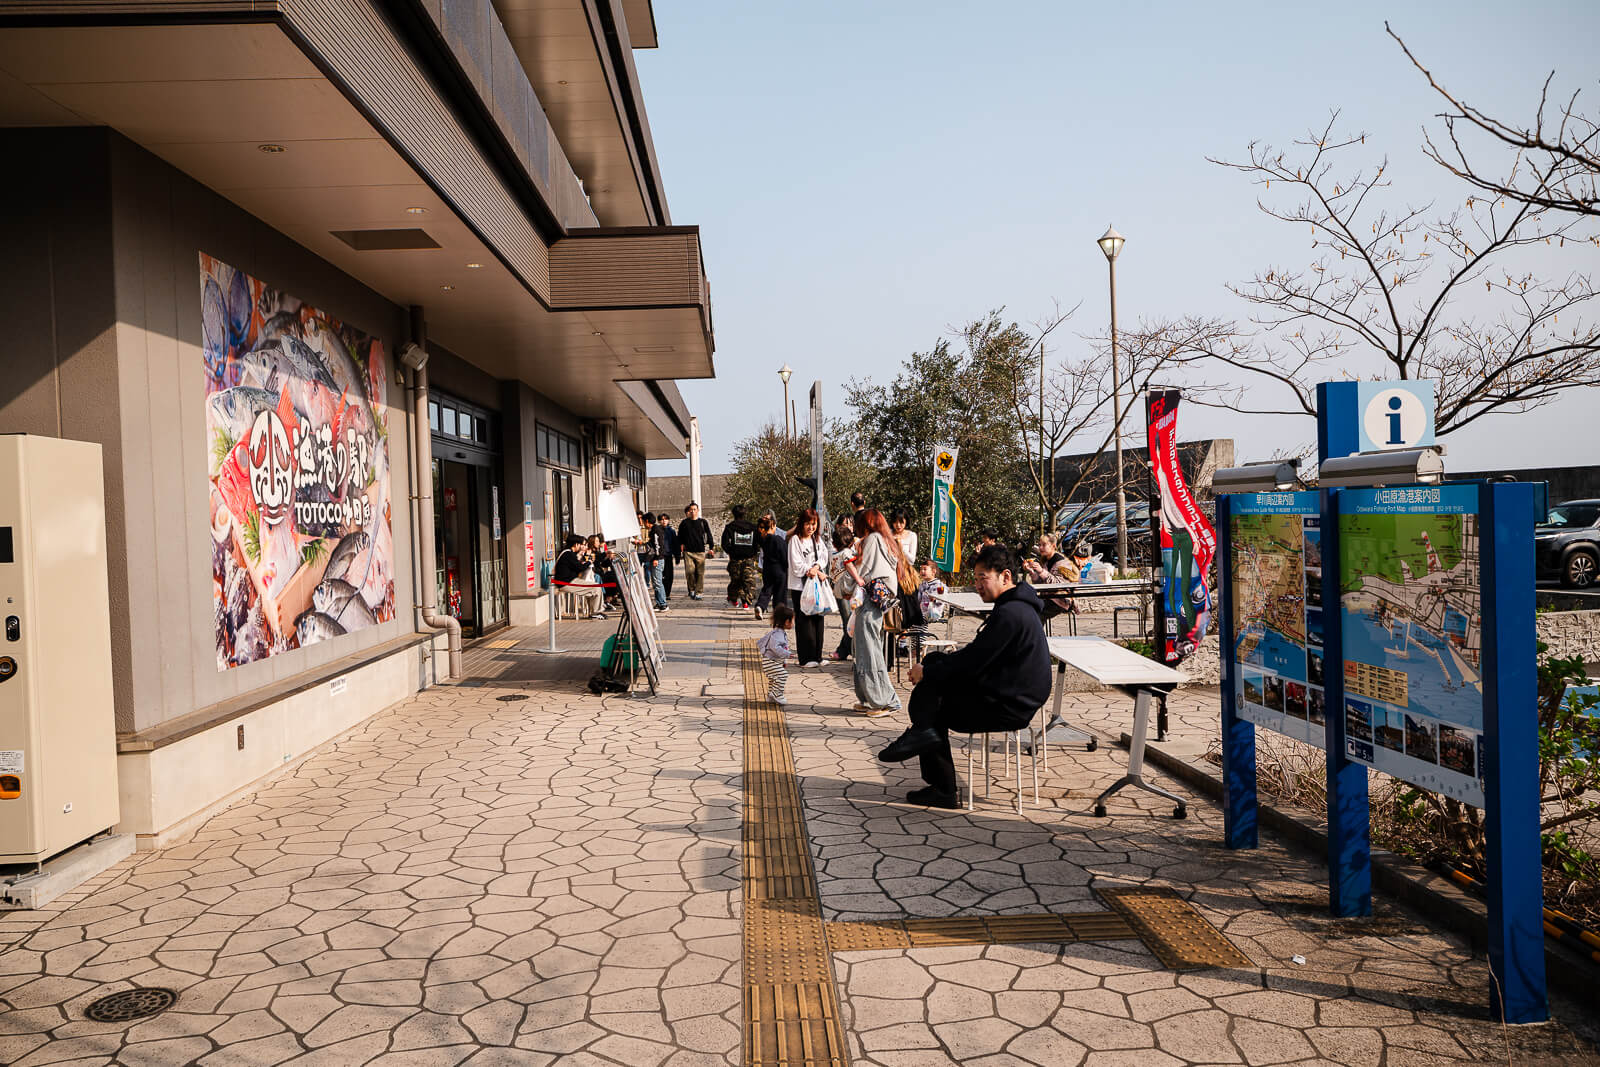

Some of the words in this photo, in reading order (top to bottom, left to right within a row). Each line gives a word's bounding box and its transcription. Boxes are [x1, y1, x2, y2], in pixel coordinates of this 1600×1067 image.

[1374, 488, 1441, 504] 小田原漁港案内図
